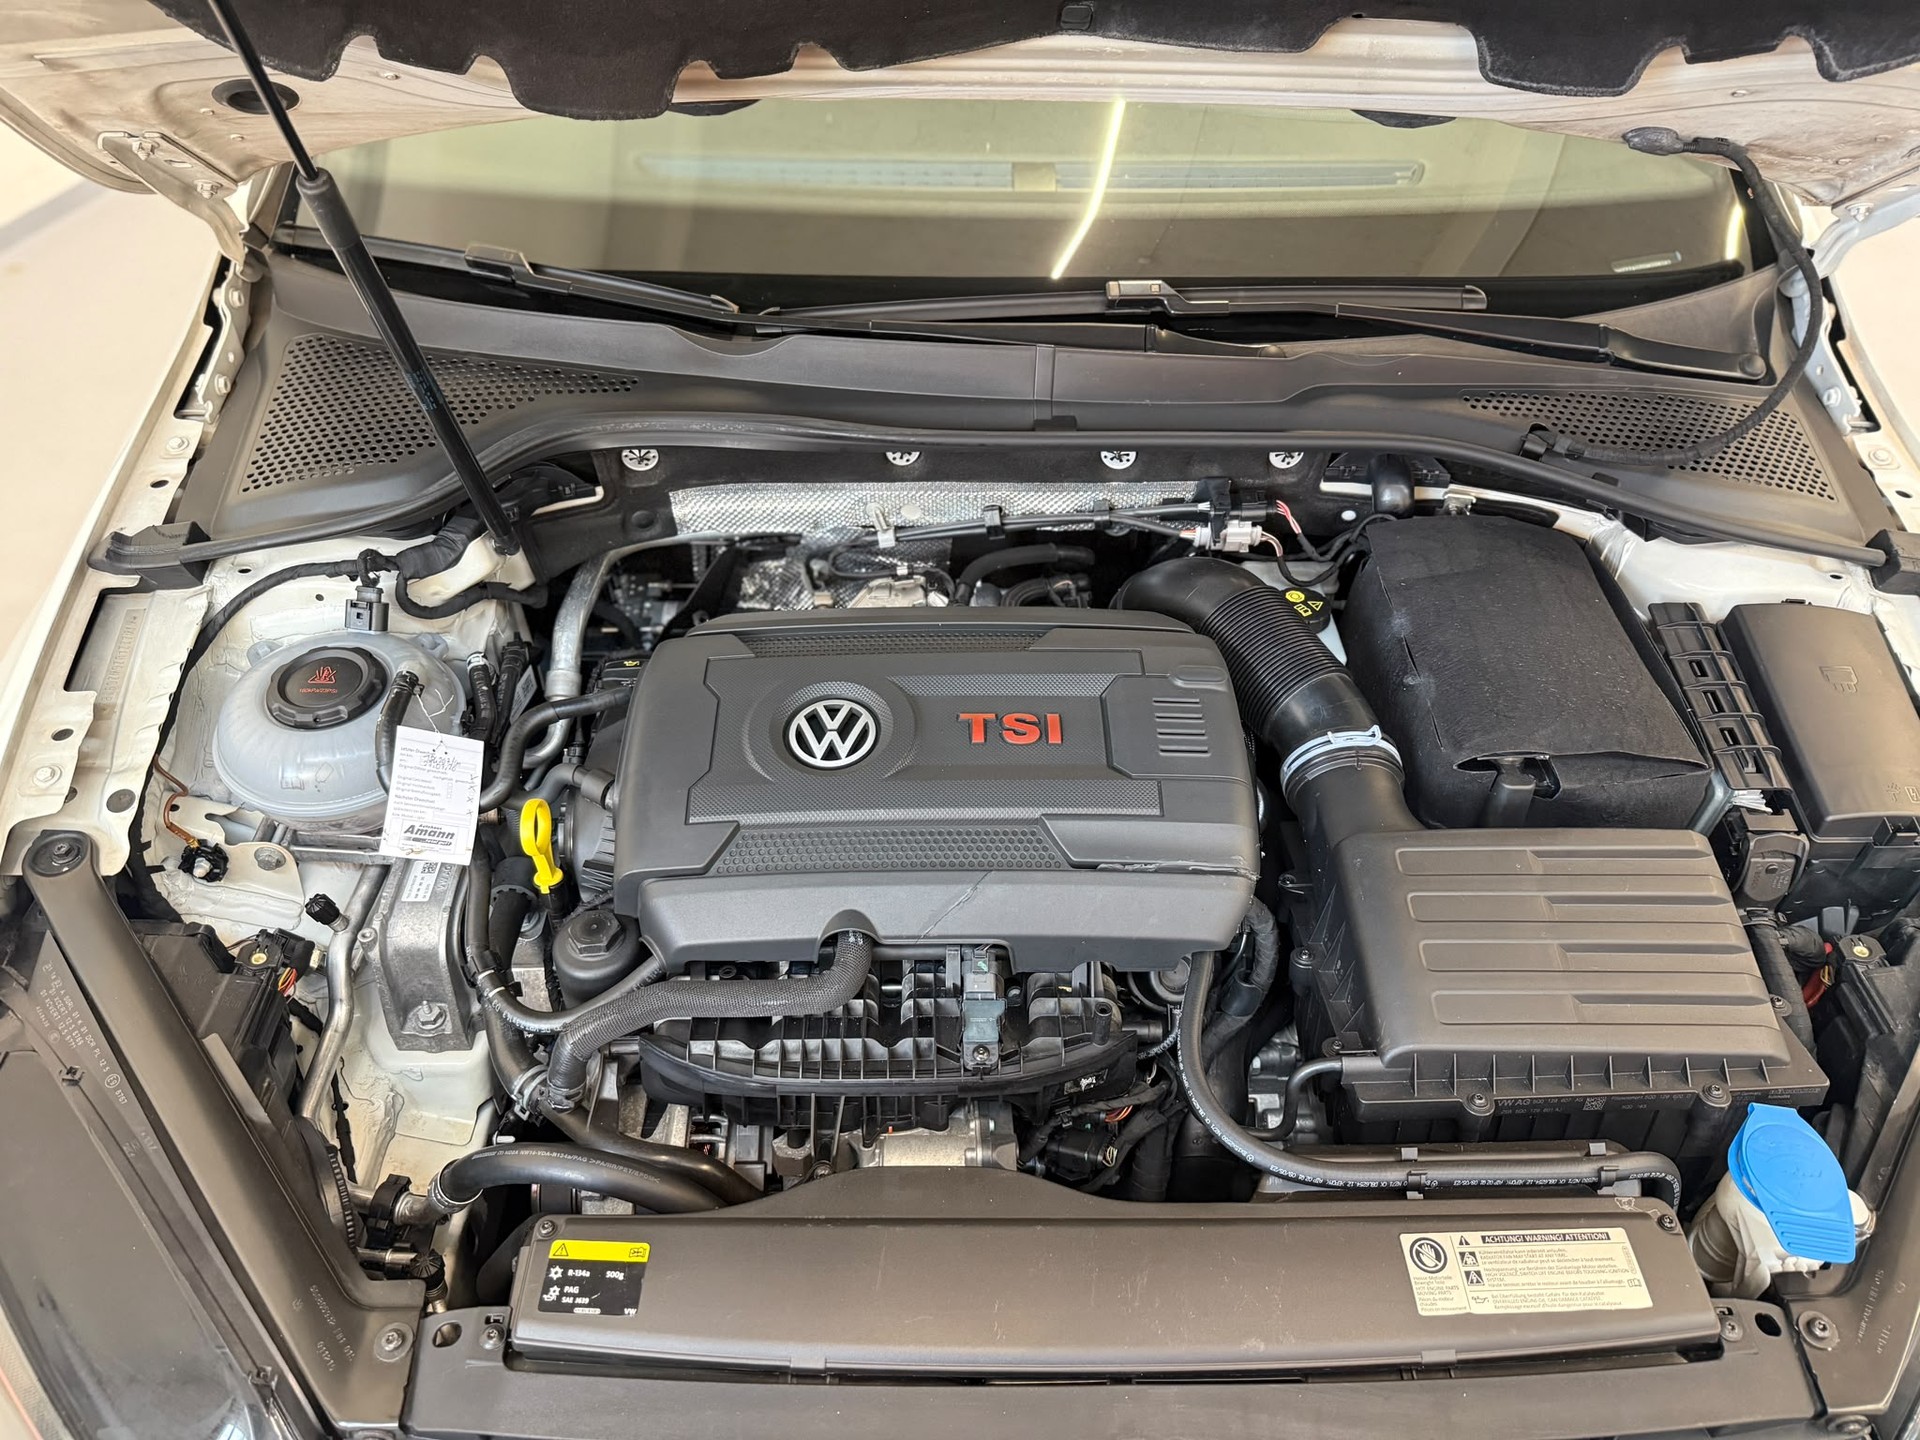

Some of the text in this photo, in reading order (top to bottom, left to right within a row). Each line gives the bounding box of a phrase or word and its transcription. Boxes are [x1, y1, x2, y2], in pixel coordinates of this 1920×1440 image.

[958, 712, 1064, 745] TSI
[404, 824, 456, 840] Amann
[1485, 1232, 1608, 1243] ACHTUNG! WARNING! ATTENTION!
[568, 1269, 624, 1281] R-134a 500g
[561, 1296, 574, 1304] SAE
